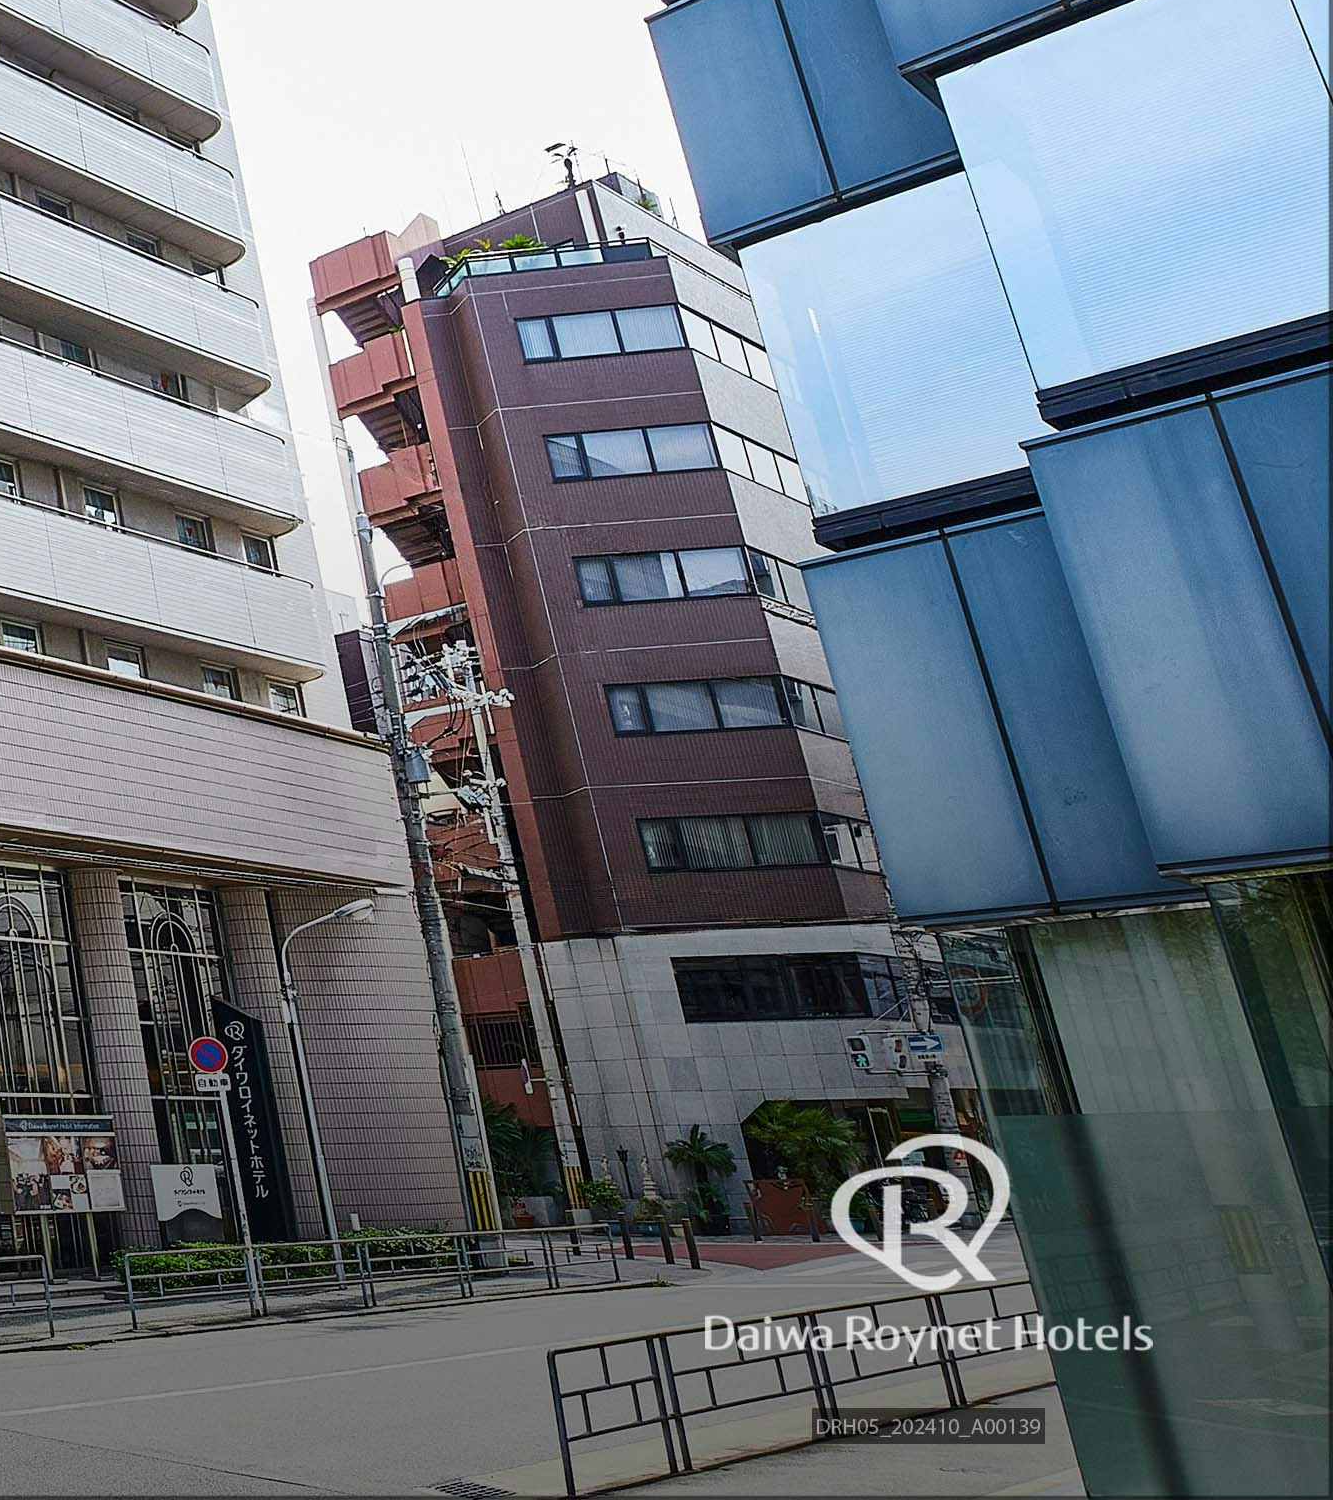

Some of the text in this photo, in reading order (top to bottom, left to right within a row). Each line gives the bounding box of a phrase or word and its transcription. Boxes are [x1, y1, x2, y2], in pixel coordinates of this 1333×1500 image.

[231, 1044, 269, 1199] ダイワロイネットホテル
